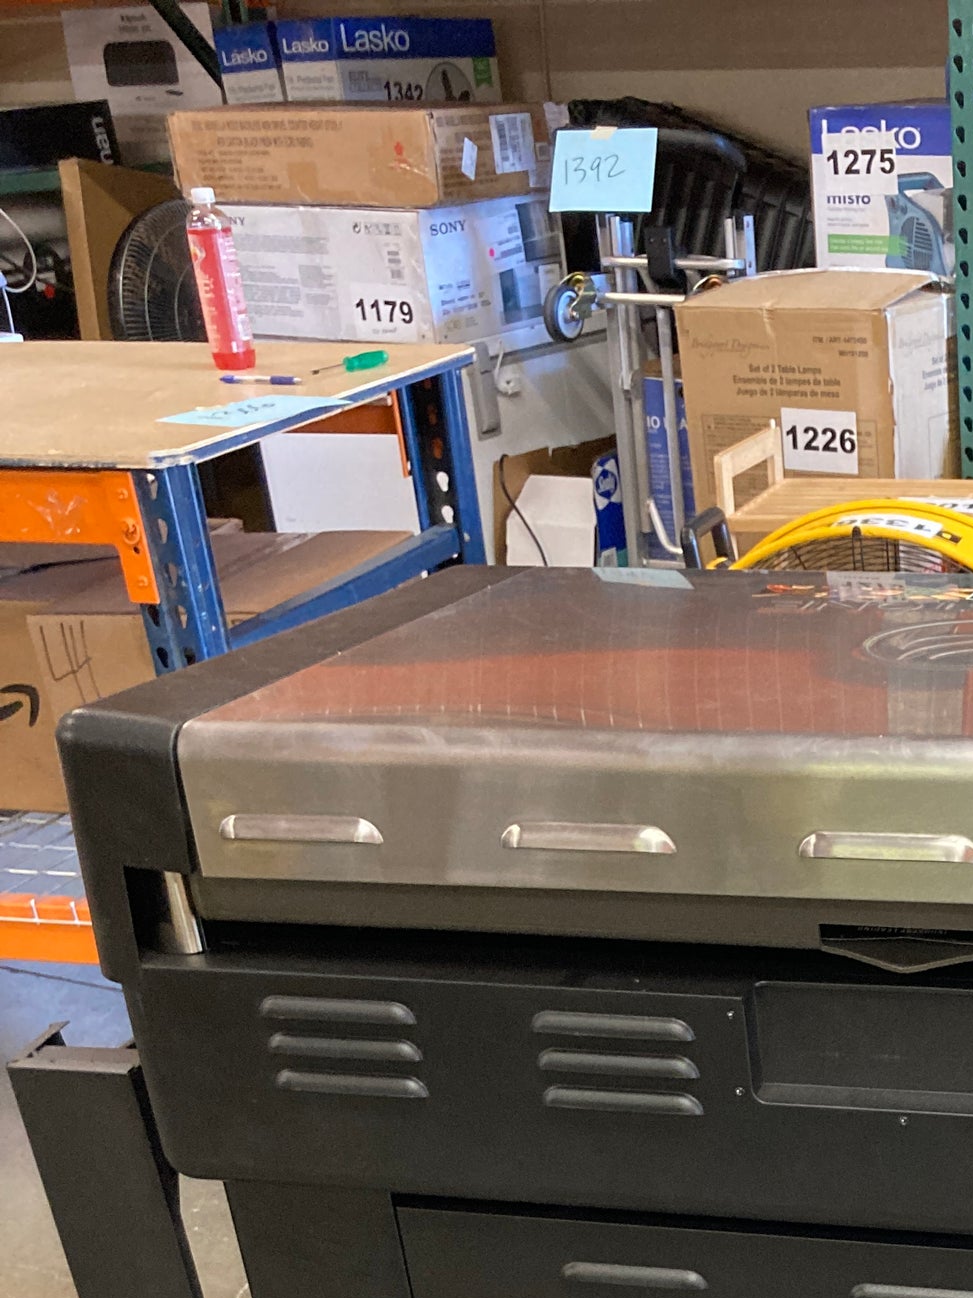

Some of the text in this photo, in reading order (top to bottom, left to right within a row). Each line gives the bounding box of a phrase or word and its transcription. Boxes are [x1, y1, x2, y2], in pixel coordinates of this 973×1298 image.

[282, 37, 329, 55] Lasko
[340, 23, 410, 52] Lasko
[222, 48, 268, 67] Lasko
[383, 80, 424, 100] 1342
[565, 154, 625, 185] 1392
[827, 149, 895, 175] 1275
[827, 195, 871, 205] misto
[430, 220, 466, 236] SONY
[356, 298, 413, 324] 1179
[786, 425, 856, 454] 1226
